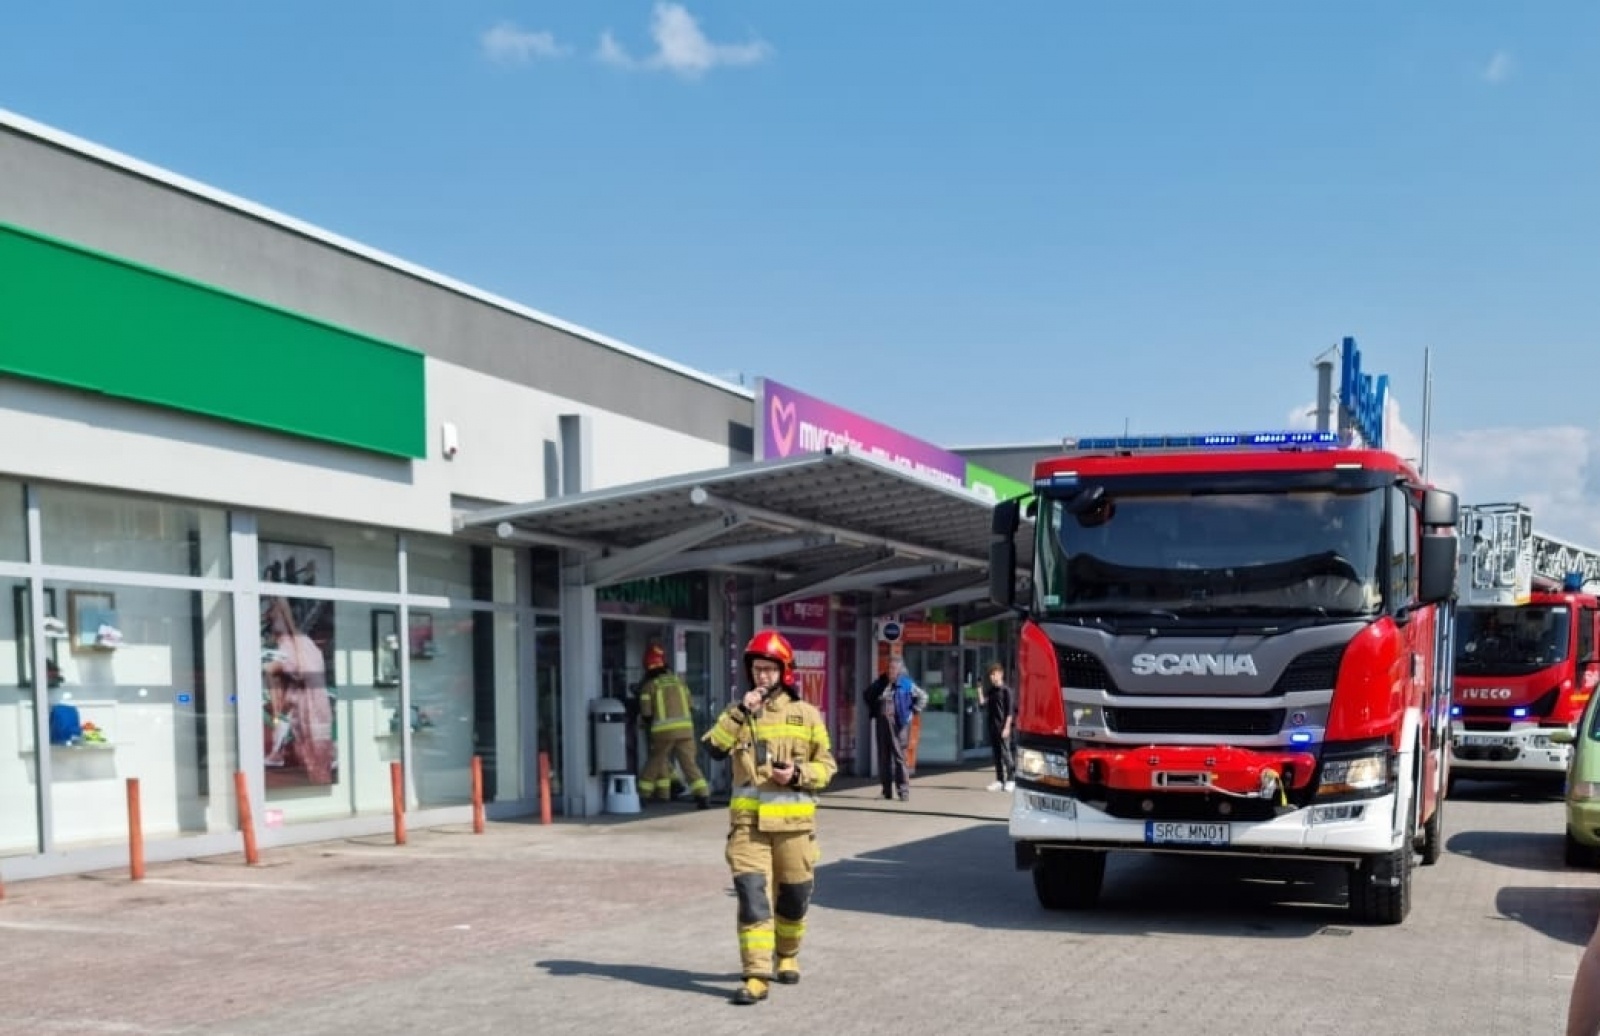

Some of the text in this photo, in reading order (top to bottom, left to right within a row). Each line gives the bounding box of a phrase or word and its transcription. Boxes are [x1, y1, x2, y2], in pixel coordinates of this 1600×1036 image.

[1132, 653, 1258, 676] SCANIA
[1462, 688, 1512, 699] IVECO
[1155, 823, 1224, 840] SRC MN01
